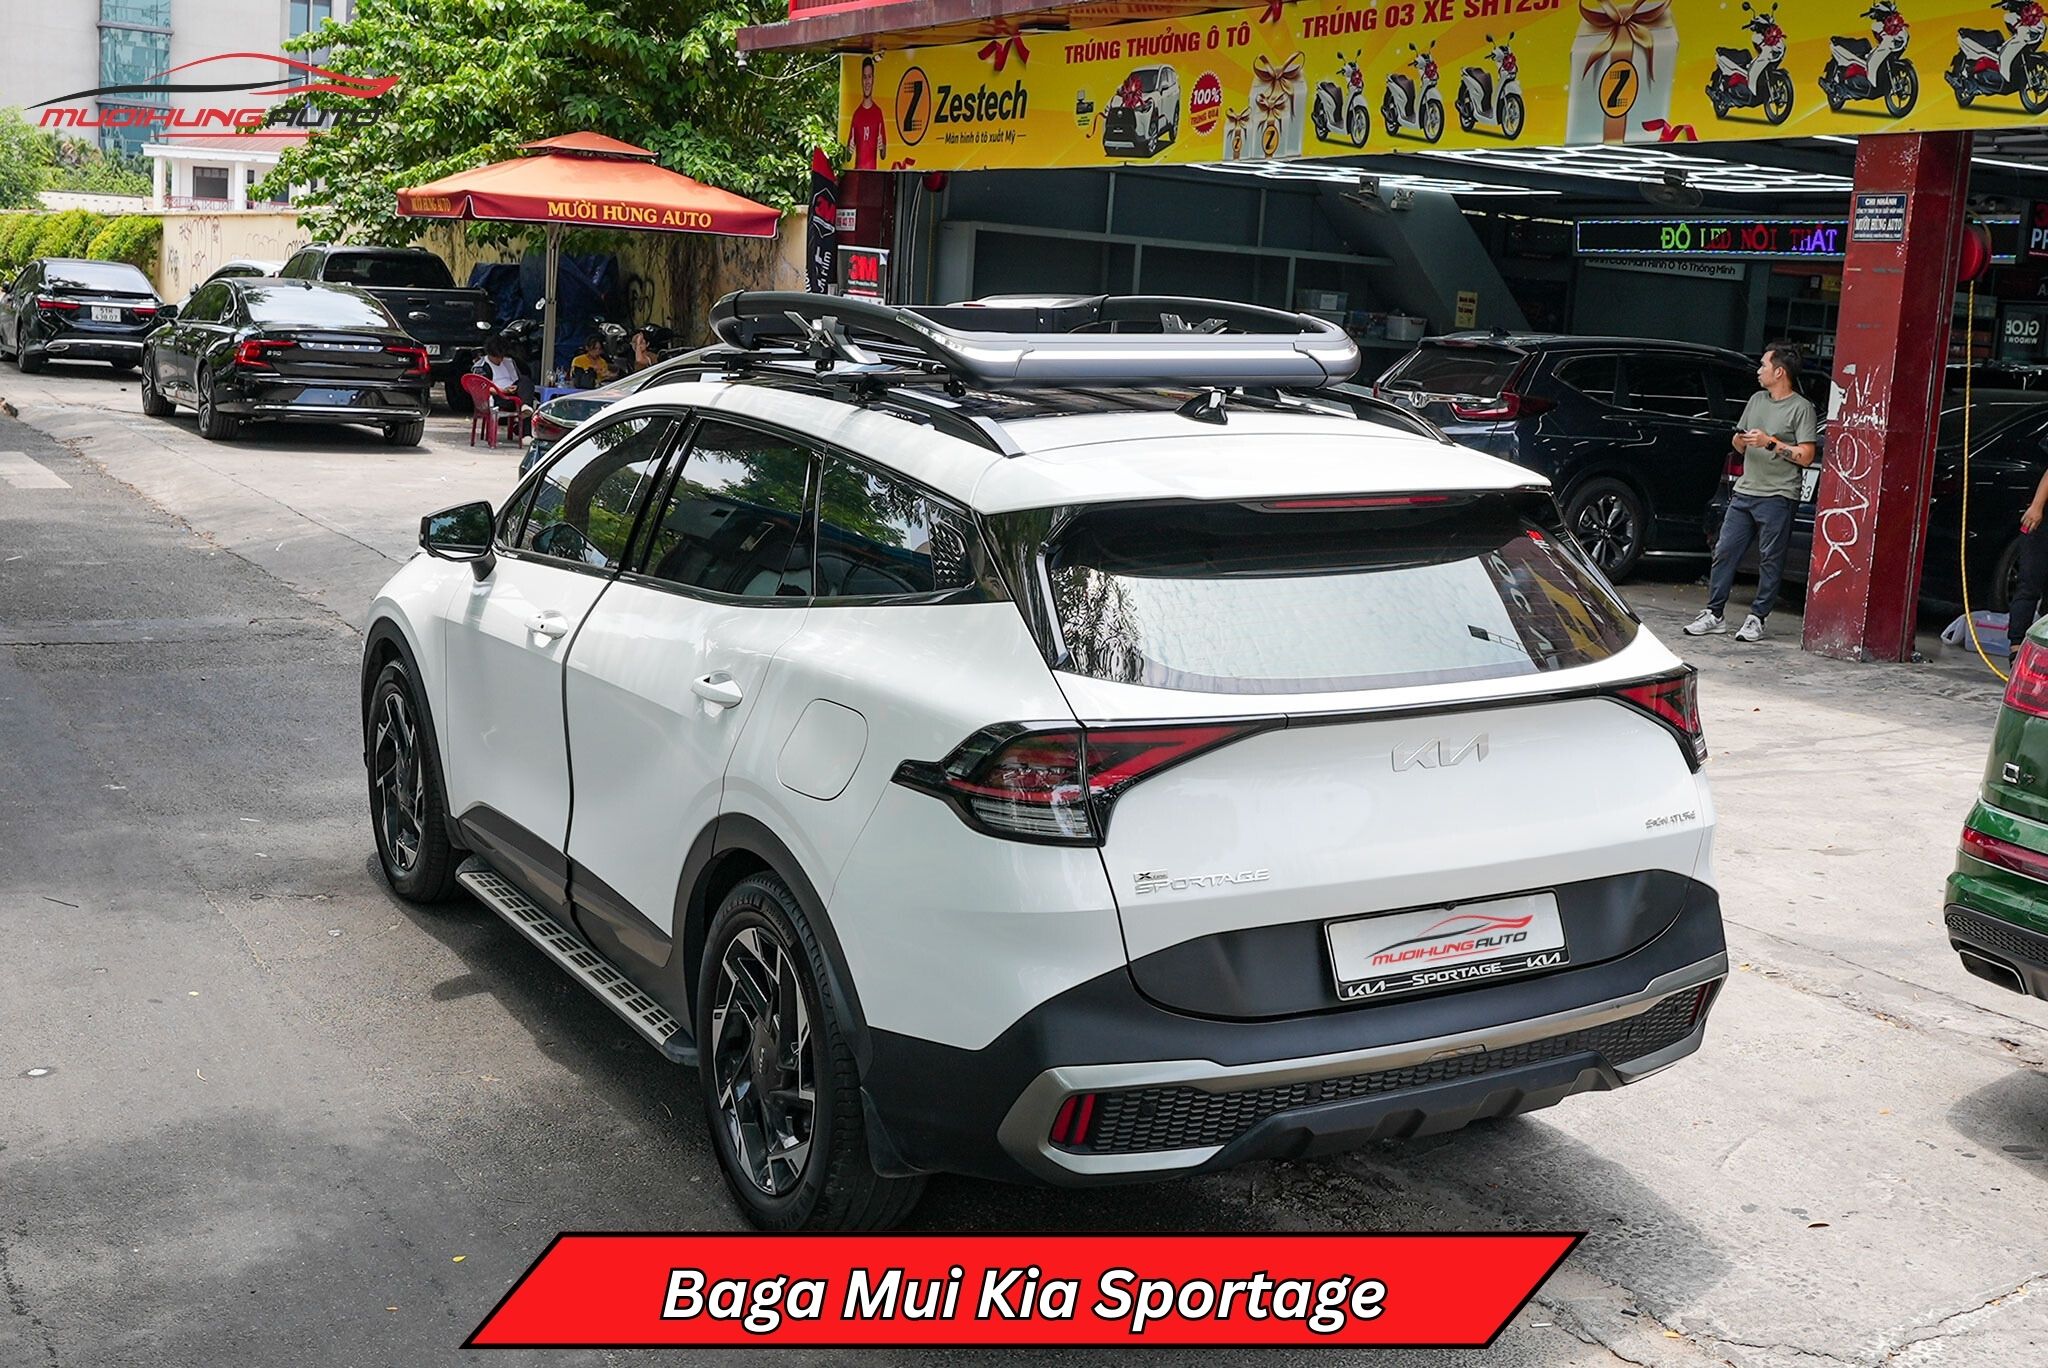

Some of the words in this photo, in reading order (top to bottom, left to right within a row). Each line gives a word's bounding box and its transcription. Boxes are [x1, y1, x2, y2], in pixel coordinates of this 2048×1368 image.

[1302, 3, 1378, 39] TRÚNG
[1384, 3, 1415, 28] 03
[1422, 0, 1454, 24] XE
[1064, 38, 1121, 64] TRÚNG
[1126, 27, 1201, 58] THƯỞNG
[1206, 25, 1220, 50] Ô
[1226, 21, 1252, 48] TÔ
[934, 80, 1028, 123] Zestech
[1193, 88, 1220, 105] 100%
[547, 200, 598, 220] MƯỜI
[602, 198, 658, 224] HÙNG
[661, 210, 712, 228] AUTO
[848, 254, 879, 281] 3M
[1391, 733, 1489, 772] KIA
[1134, 868, 1271, 894] SPORTAGE
[1346, 980, 1386, 997] KIA
[1411, 962, 1502, 986] SPORTAGE
[1525, 952, 1561, 968] KIA
